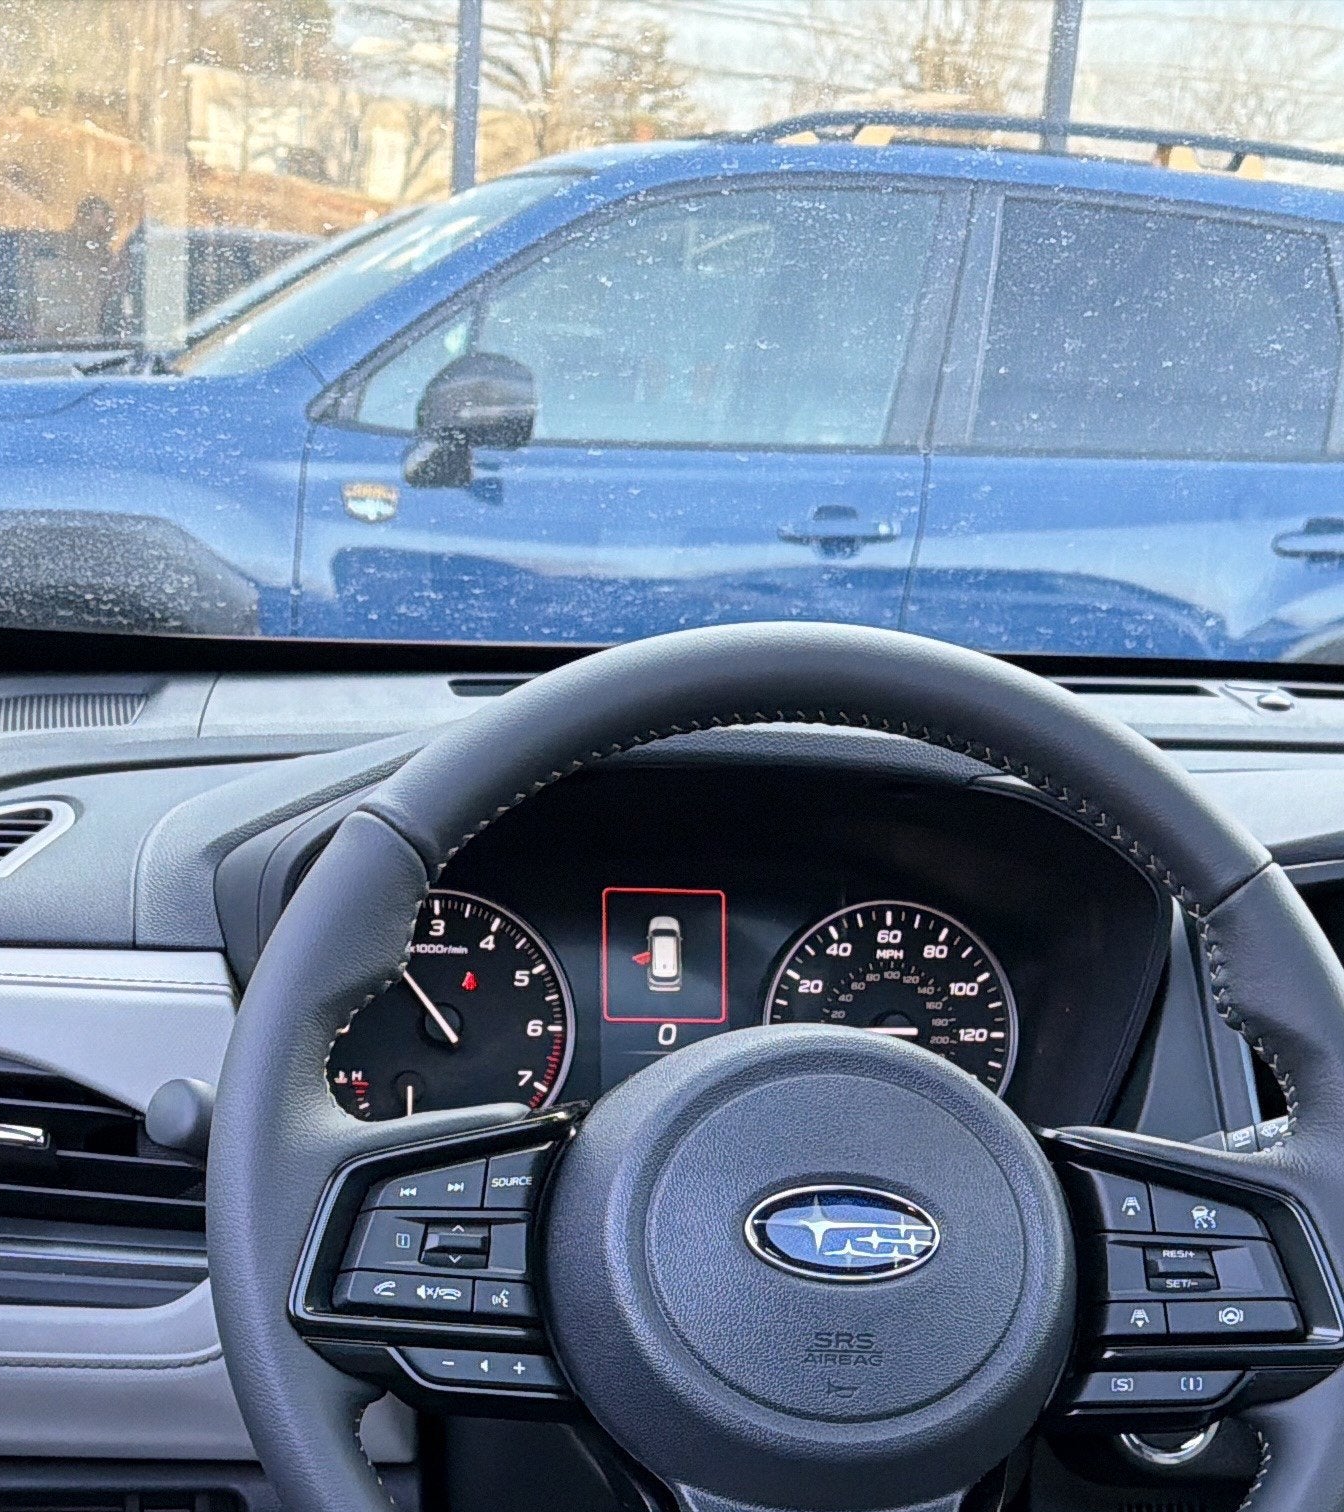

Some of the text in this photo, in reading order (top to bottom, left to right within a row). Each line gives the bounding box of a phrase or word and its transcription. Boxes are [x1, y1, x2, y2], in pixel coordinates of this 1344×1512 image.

[429, 919, 446, 936] 3
[479, 935, 496, 951] 4
[877, 929, 902, 944] 60
[826, 942, 853, 957] 40
[876, 949, 904, 960] MPH
[923, 945, 948, 959] 80
[513, 970, 531, 987] 5
[798, 979, 823, 993] 20
[949, 982, 979, 997] 100
[830, 1009, 846, 1019] 20
[527, 1019, 544, 1037] 6
[959, 1028, 988, 1042] 120
[351, 1070, 363, 1081] H
[517, 1070, 533, 1087] 7
[490, 1175, 533, 1188] SOURCE
[813, 1331, 876, 1350] SRS
[803, 1353, 885, 1367] AIRBAG
